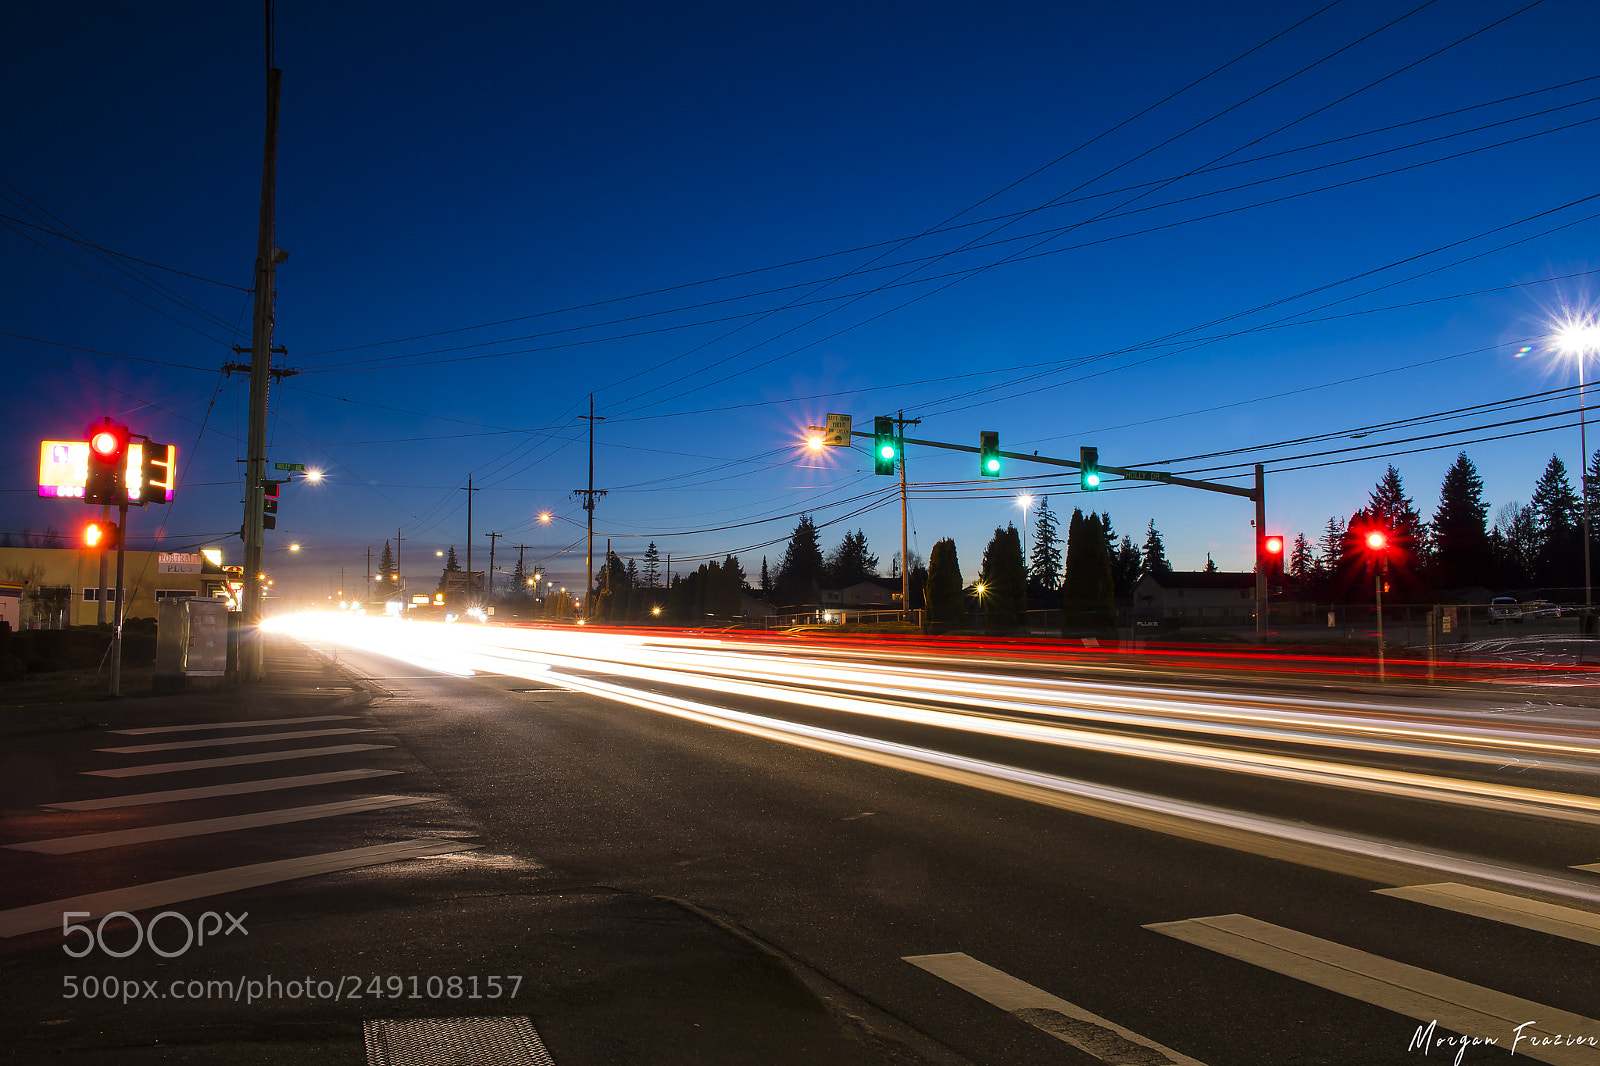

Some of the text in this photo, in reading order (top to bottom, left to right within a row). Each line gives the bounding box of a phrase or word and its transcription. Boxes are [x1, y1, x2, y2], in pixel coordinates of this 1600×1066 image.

[1125, 471, 1161, 481] HOLLY DR
[160, 554, 200, 563] PORTRAITS
[167, 564, 193, 573] PLUS
